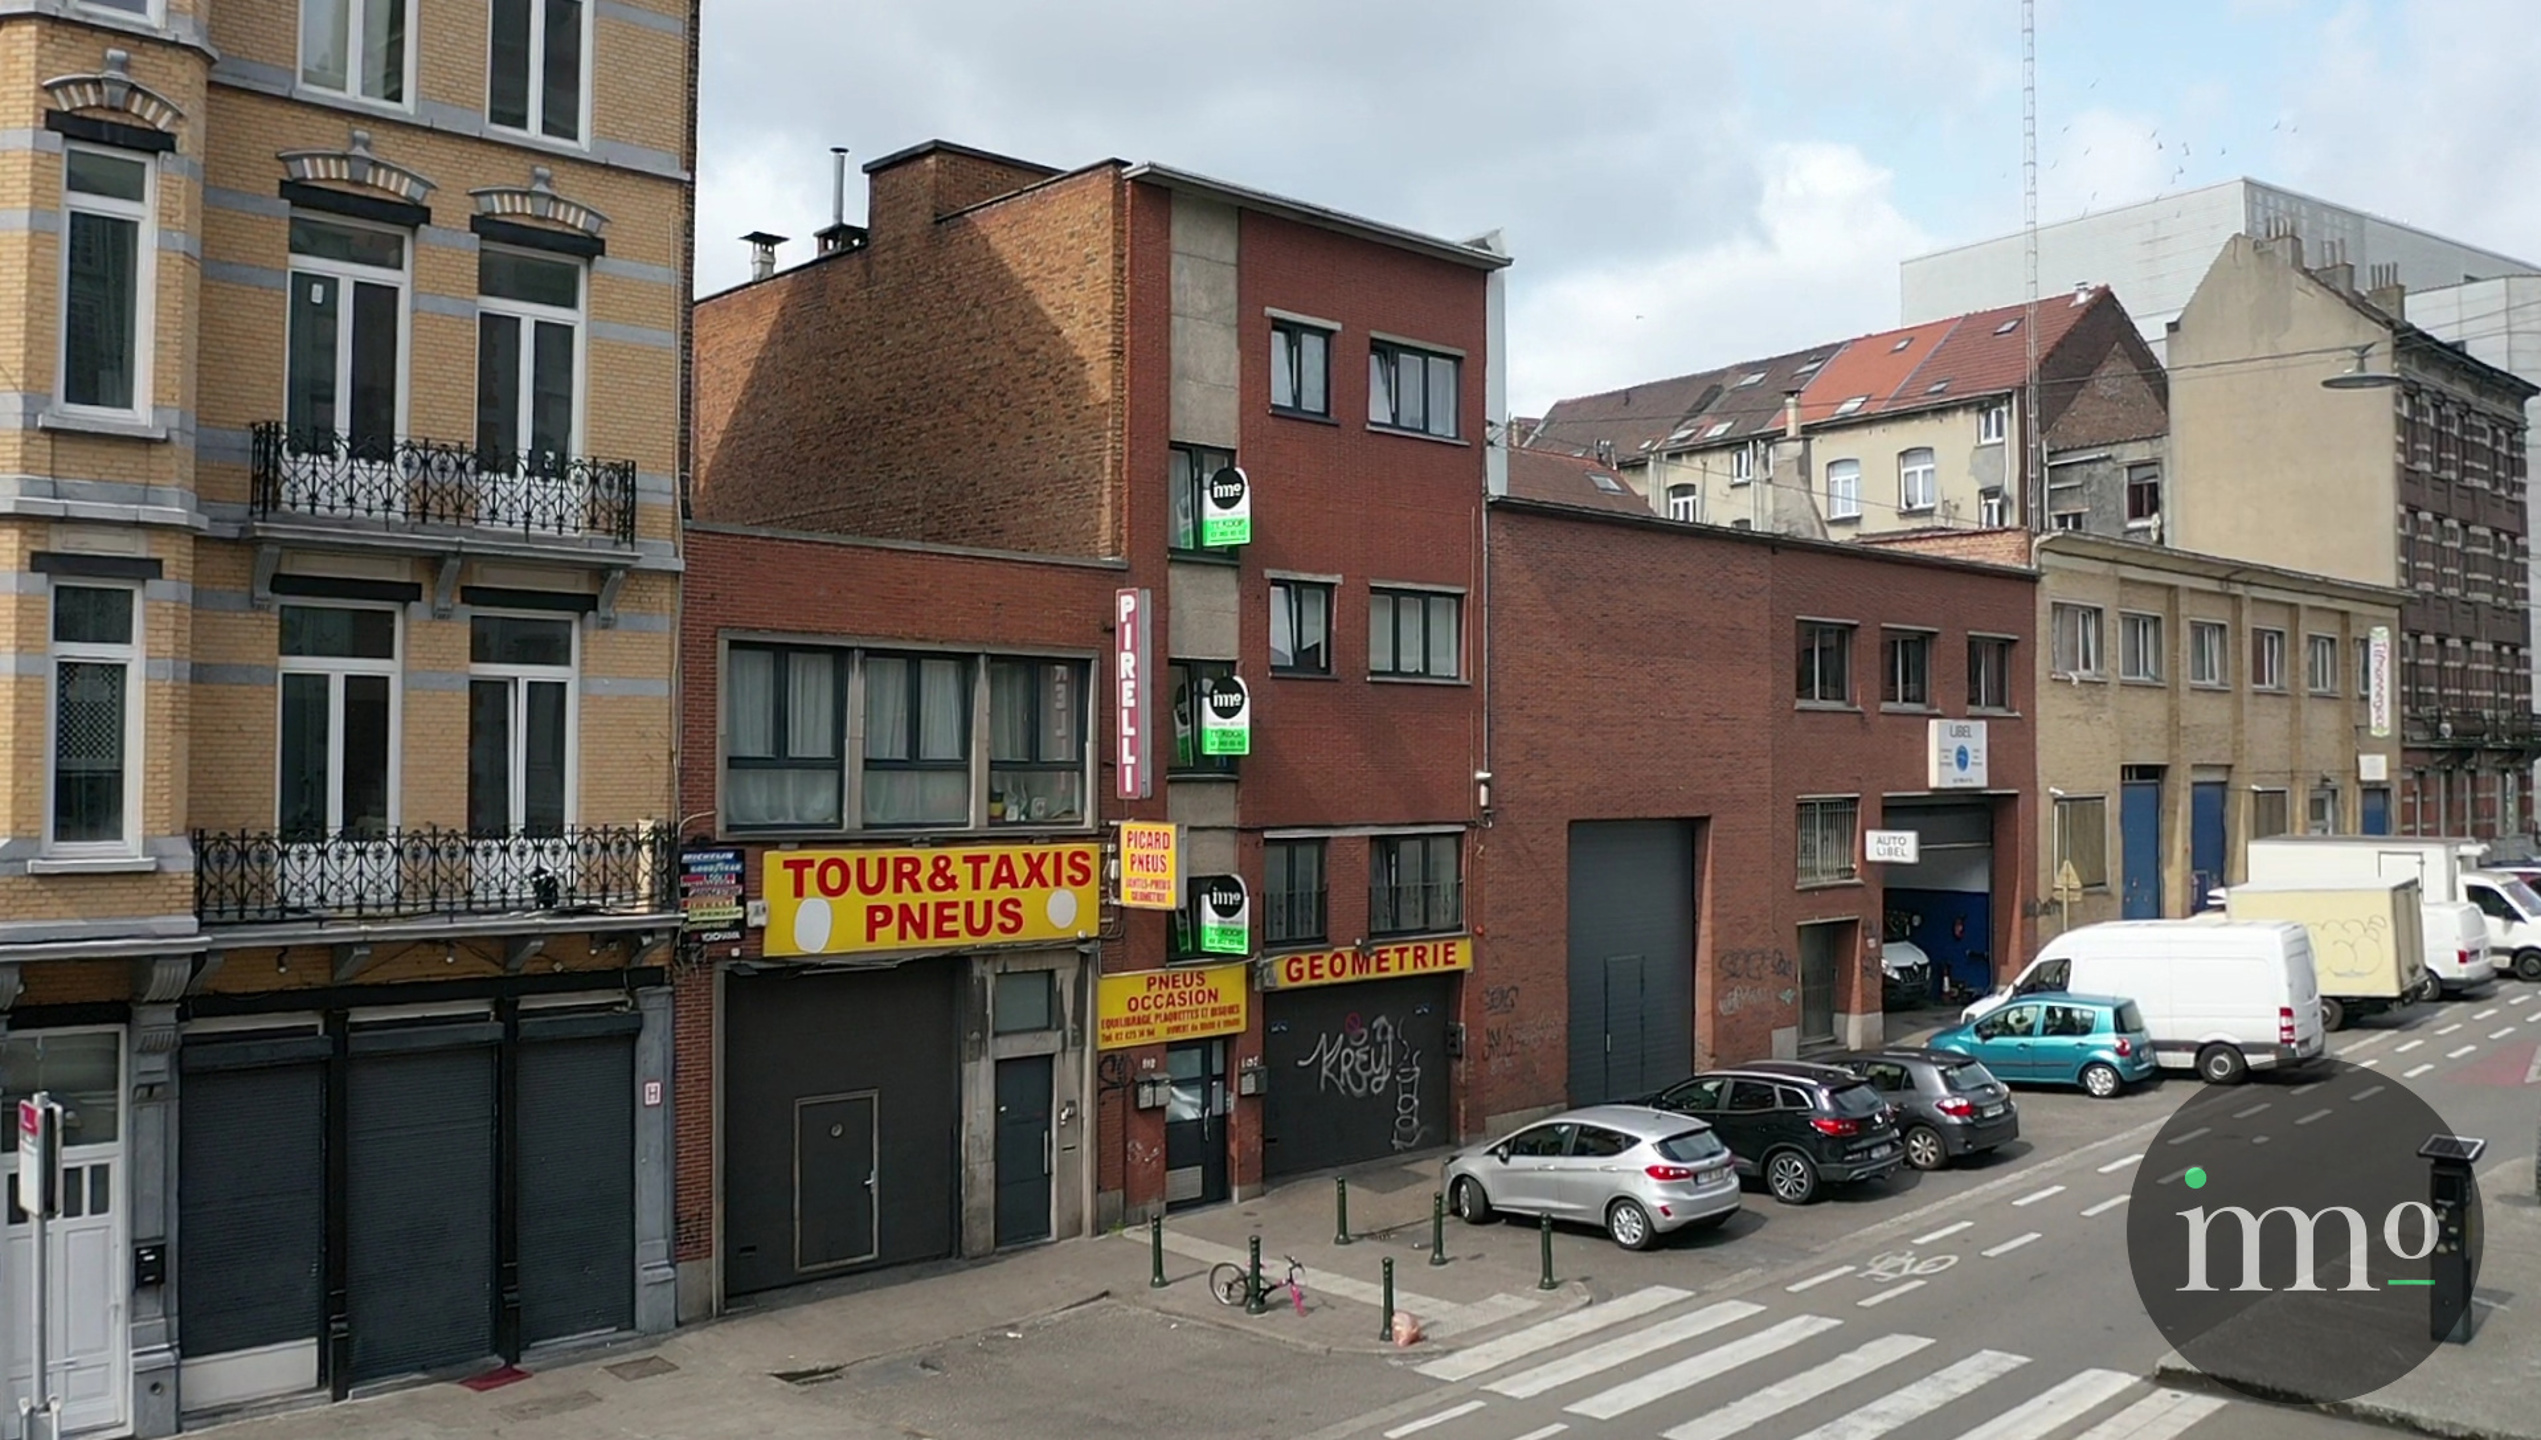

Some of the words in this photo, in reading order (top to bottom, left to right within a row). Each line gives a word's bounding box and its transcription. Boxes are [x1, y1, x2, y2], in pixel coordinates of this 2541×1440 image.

[1120, 595, 1136, 793] PIRELLI
[1127, 830, 1171, 850] PICARD
[1877, 836, 1907, 846] AUTO
[682, 852, 735, 862] MICHELIN
[1877, 846, 1907, 857] LIBEL
[1130, 853, 1167, 873] PNEUS
[783, 850, 1092, 898] TOUR&TAXIS
[866, 898, 1024, 942] PNEUS
[1286, 942, 1457, 983] GEOMETRIE
[1146, 971, 1206, 992] PNEUS
[1127, 988, 1219, 1012] OCCASION
[648, 1085, 659, 1101] H
